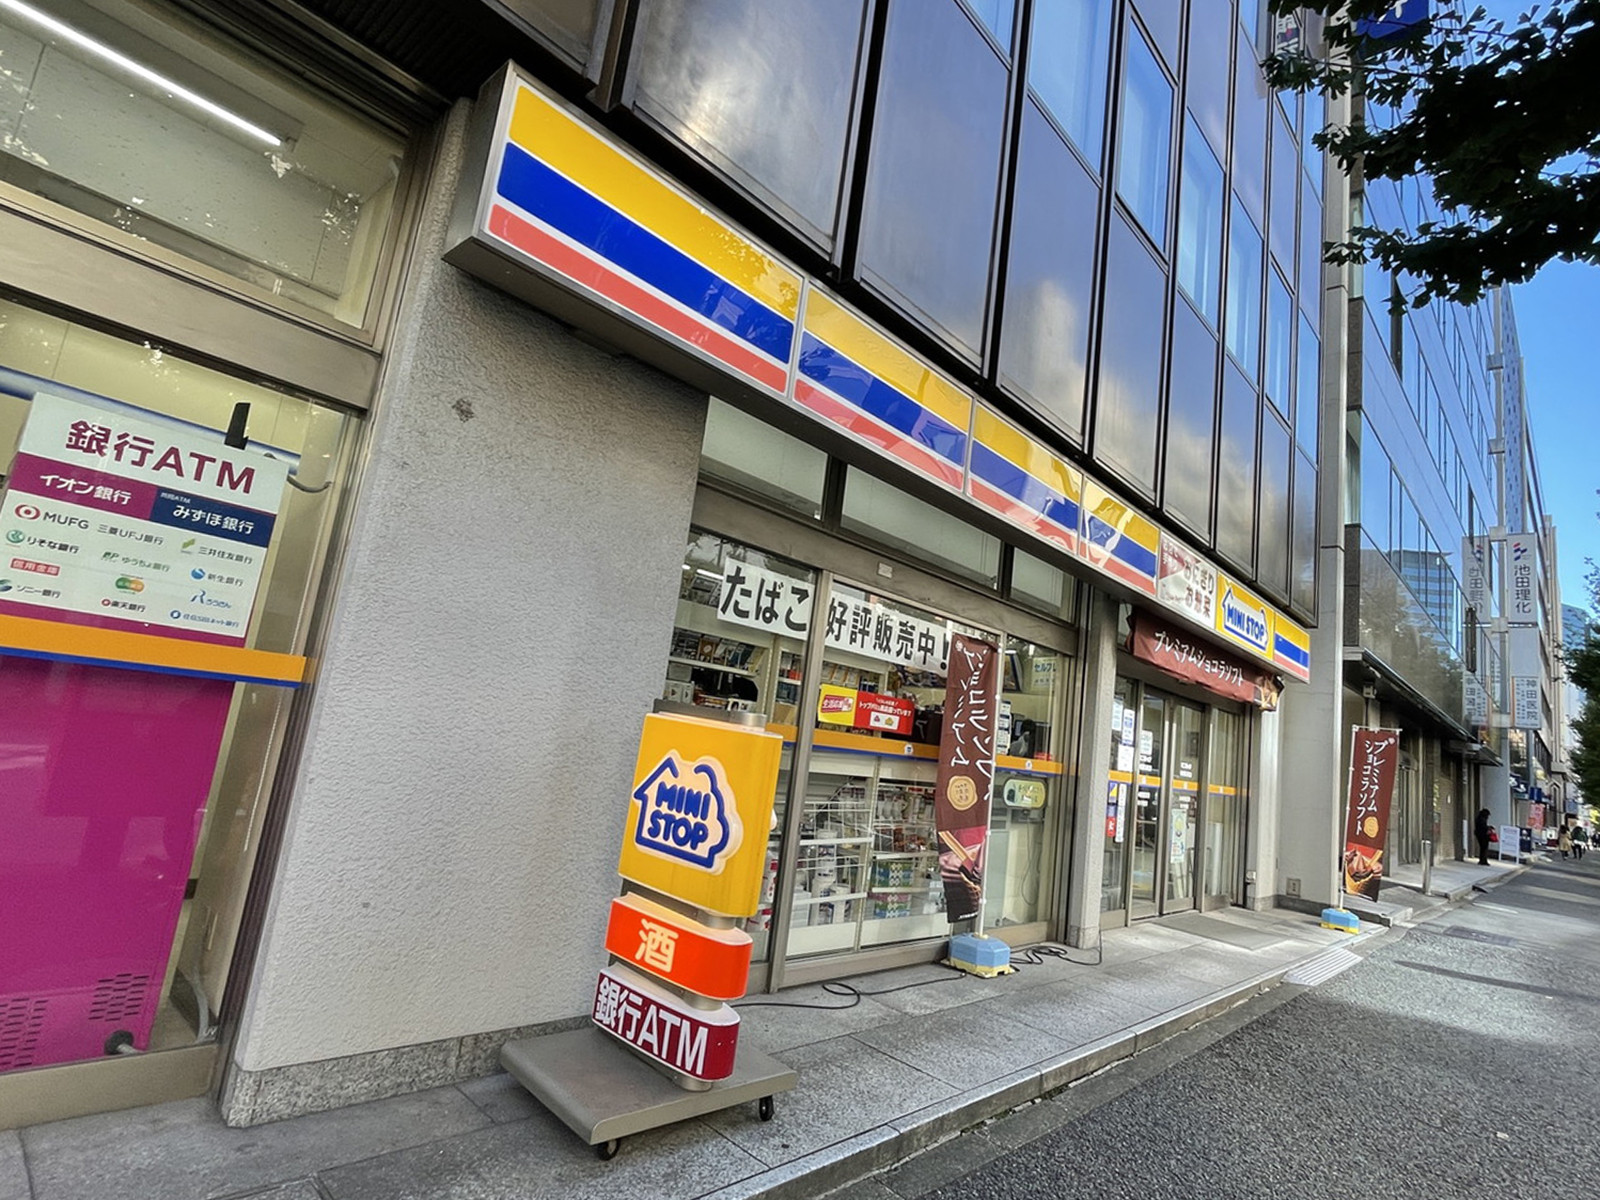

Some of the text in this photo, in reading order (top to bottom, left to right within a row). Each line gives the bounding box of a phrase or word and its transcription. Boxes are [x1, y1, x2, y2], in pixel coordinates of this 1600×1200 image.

[65, 420, 256, 494] 銀行ATM
[40, 474, 131, 505] イオン銀行
[42, 511, 90, 530] MUFG
[97, 523, 164, 546] 三菱UFJ銀行
[172, 504, 255, 535] みずほ銀行
[26, 536, 80, 554] りそな銀行
[198, 546, 254, 565] 三井住友銀行
[16, 584, 61, 599] ソニー銀行
[720, 565, 810, 632] たばこ
[1514, 564, 1532, 614] 池田理化
[1226, 604, 1265, 641] MINI STOP
[1154, 631, 1244, 687] プレミアムショコラソフト
[1355, 740, 1374, 836] ショコラソフト
[1367, 737, 1396, 812] プレミアム
[655, 781, 712, 821] MINI
[647, 809, 710, 850] STOP
[634, 918, 680, 973] 酒
[594, 976, 709, 1076] 銀行ATM
